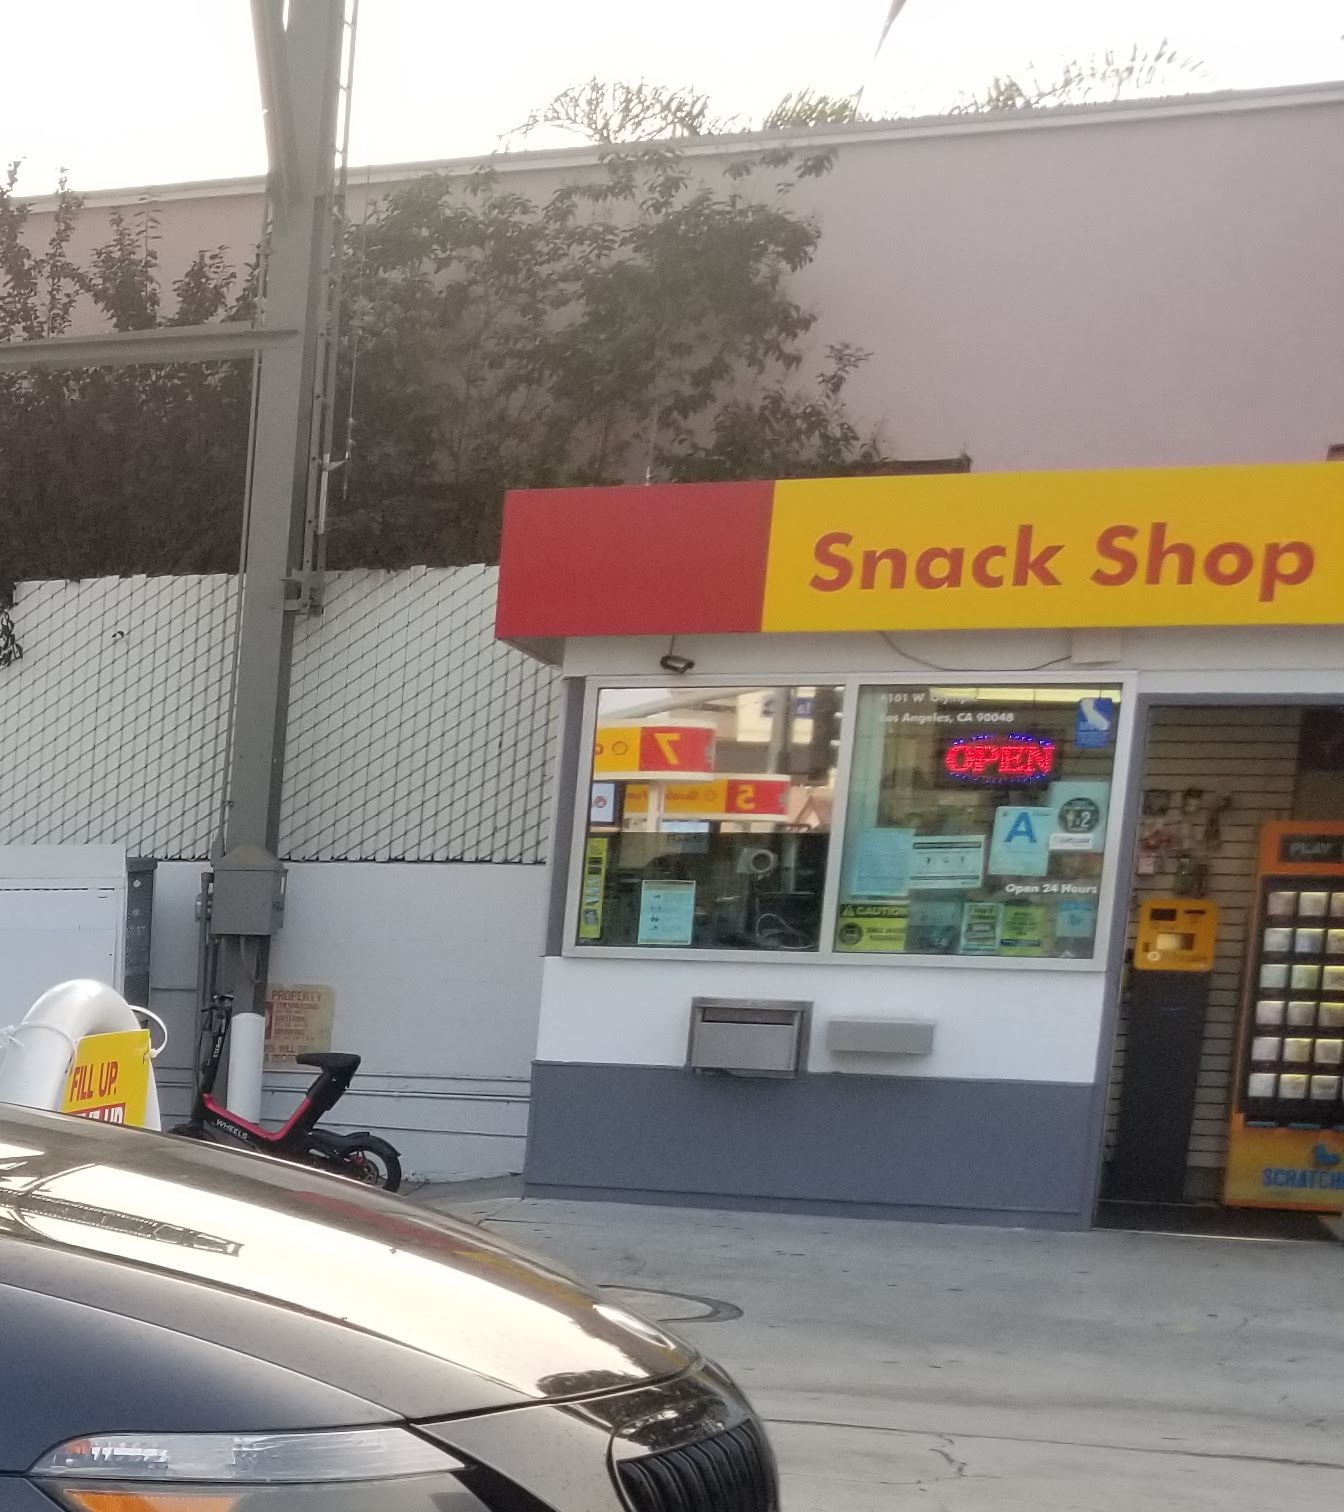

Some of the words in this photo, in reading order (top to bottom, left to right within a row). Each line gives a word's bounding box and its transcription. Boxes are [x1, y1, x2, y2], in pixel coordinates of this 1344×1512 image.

[808, 523, 1066, 593] Snack
[1089, 520, 1315, 603] Shop
[913, 693, 925, 702] W
[902, 713, 953, 724] Angeles,
[957, 712, 973, 722] CA
[945, 744, 1056, 774] OPEN
[1003, 811, 1037, 843] A
[1005, 884, 1039, 895] Open
[1042, 884, 1057, 893] 24
[1061, 884, 1097, 894] Hours
[272, 990, 321, 1001] PROPERTY
[69, 1064, 94, 1103] FILL
[98, 1061, 118, 1098] UP.
[216, 1119, 249, 1139] WHEELS
